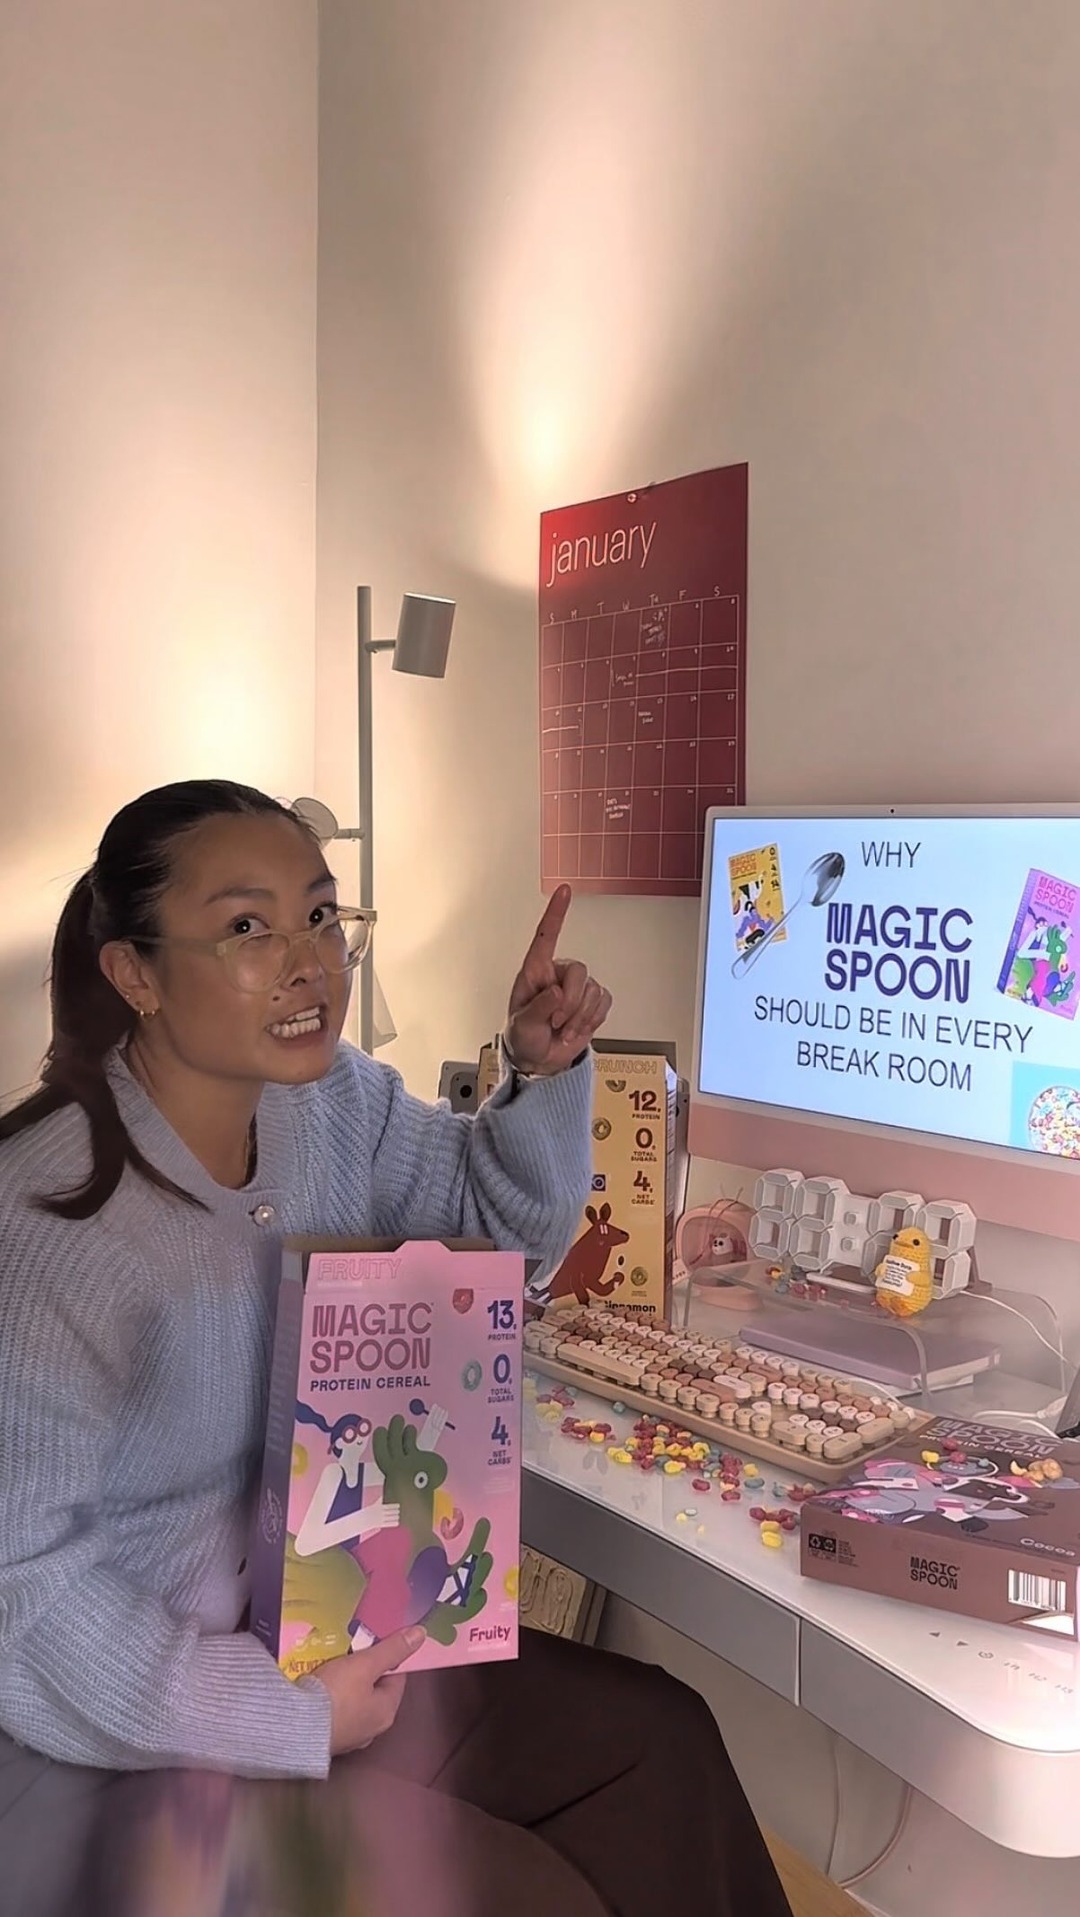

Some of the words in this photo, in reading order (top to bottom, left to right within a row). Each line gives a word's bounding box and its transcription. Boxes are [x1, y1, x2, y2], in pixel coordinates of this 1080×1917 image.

[546, 521, 657, 588] january
[597, 602, 604, 615] T
[679, 589, 687, 601] F
[714, 585, 720, 597] S
[861, 841, 921, 868] WHY
[1035, 888, 1074, 913] SPOON
[1039, 876, 1077, 901] MAGIC
[826, 902, 974, 953] MAGIC
[824, 949, 970, 1004] SPOON
[754, 996, 850, 1030] SHOULD
[859, 1007, 892, 1036] BE
[902, 1013, 926, 1040] IN
[936, 1016, 1033, 1054] EVERY
[797, 1041, 880, 1077] BREAK
[888, 1054, 972, 1091] ROOM
[318, 1258, 402, 1280] FRUITY
[312, 1302, 432, 1338] MAGIC
[488, 1333, 516, 1341] PROTEIN
[310, 1338, 431, 1374] SPOON
[310, 1378, 371, 1392] PROTEIN
[376, 1376, 431, 1389] CEREAL
[926, 1427, 1055, 1455] SPOON
[937, 1419, 1063, 1447] MAGIC
[984, 1445, 1042, 1459] CEREAL
[1020, 1538, 1075, 1556] Cocoa
[910, 1556, 960, 1577] MAGIC
[910, 1569, 957, 1590] SPOON
[469, 1625, 511, 1642] Fruity
